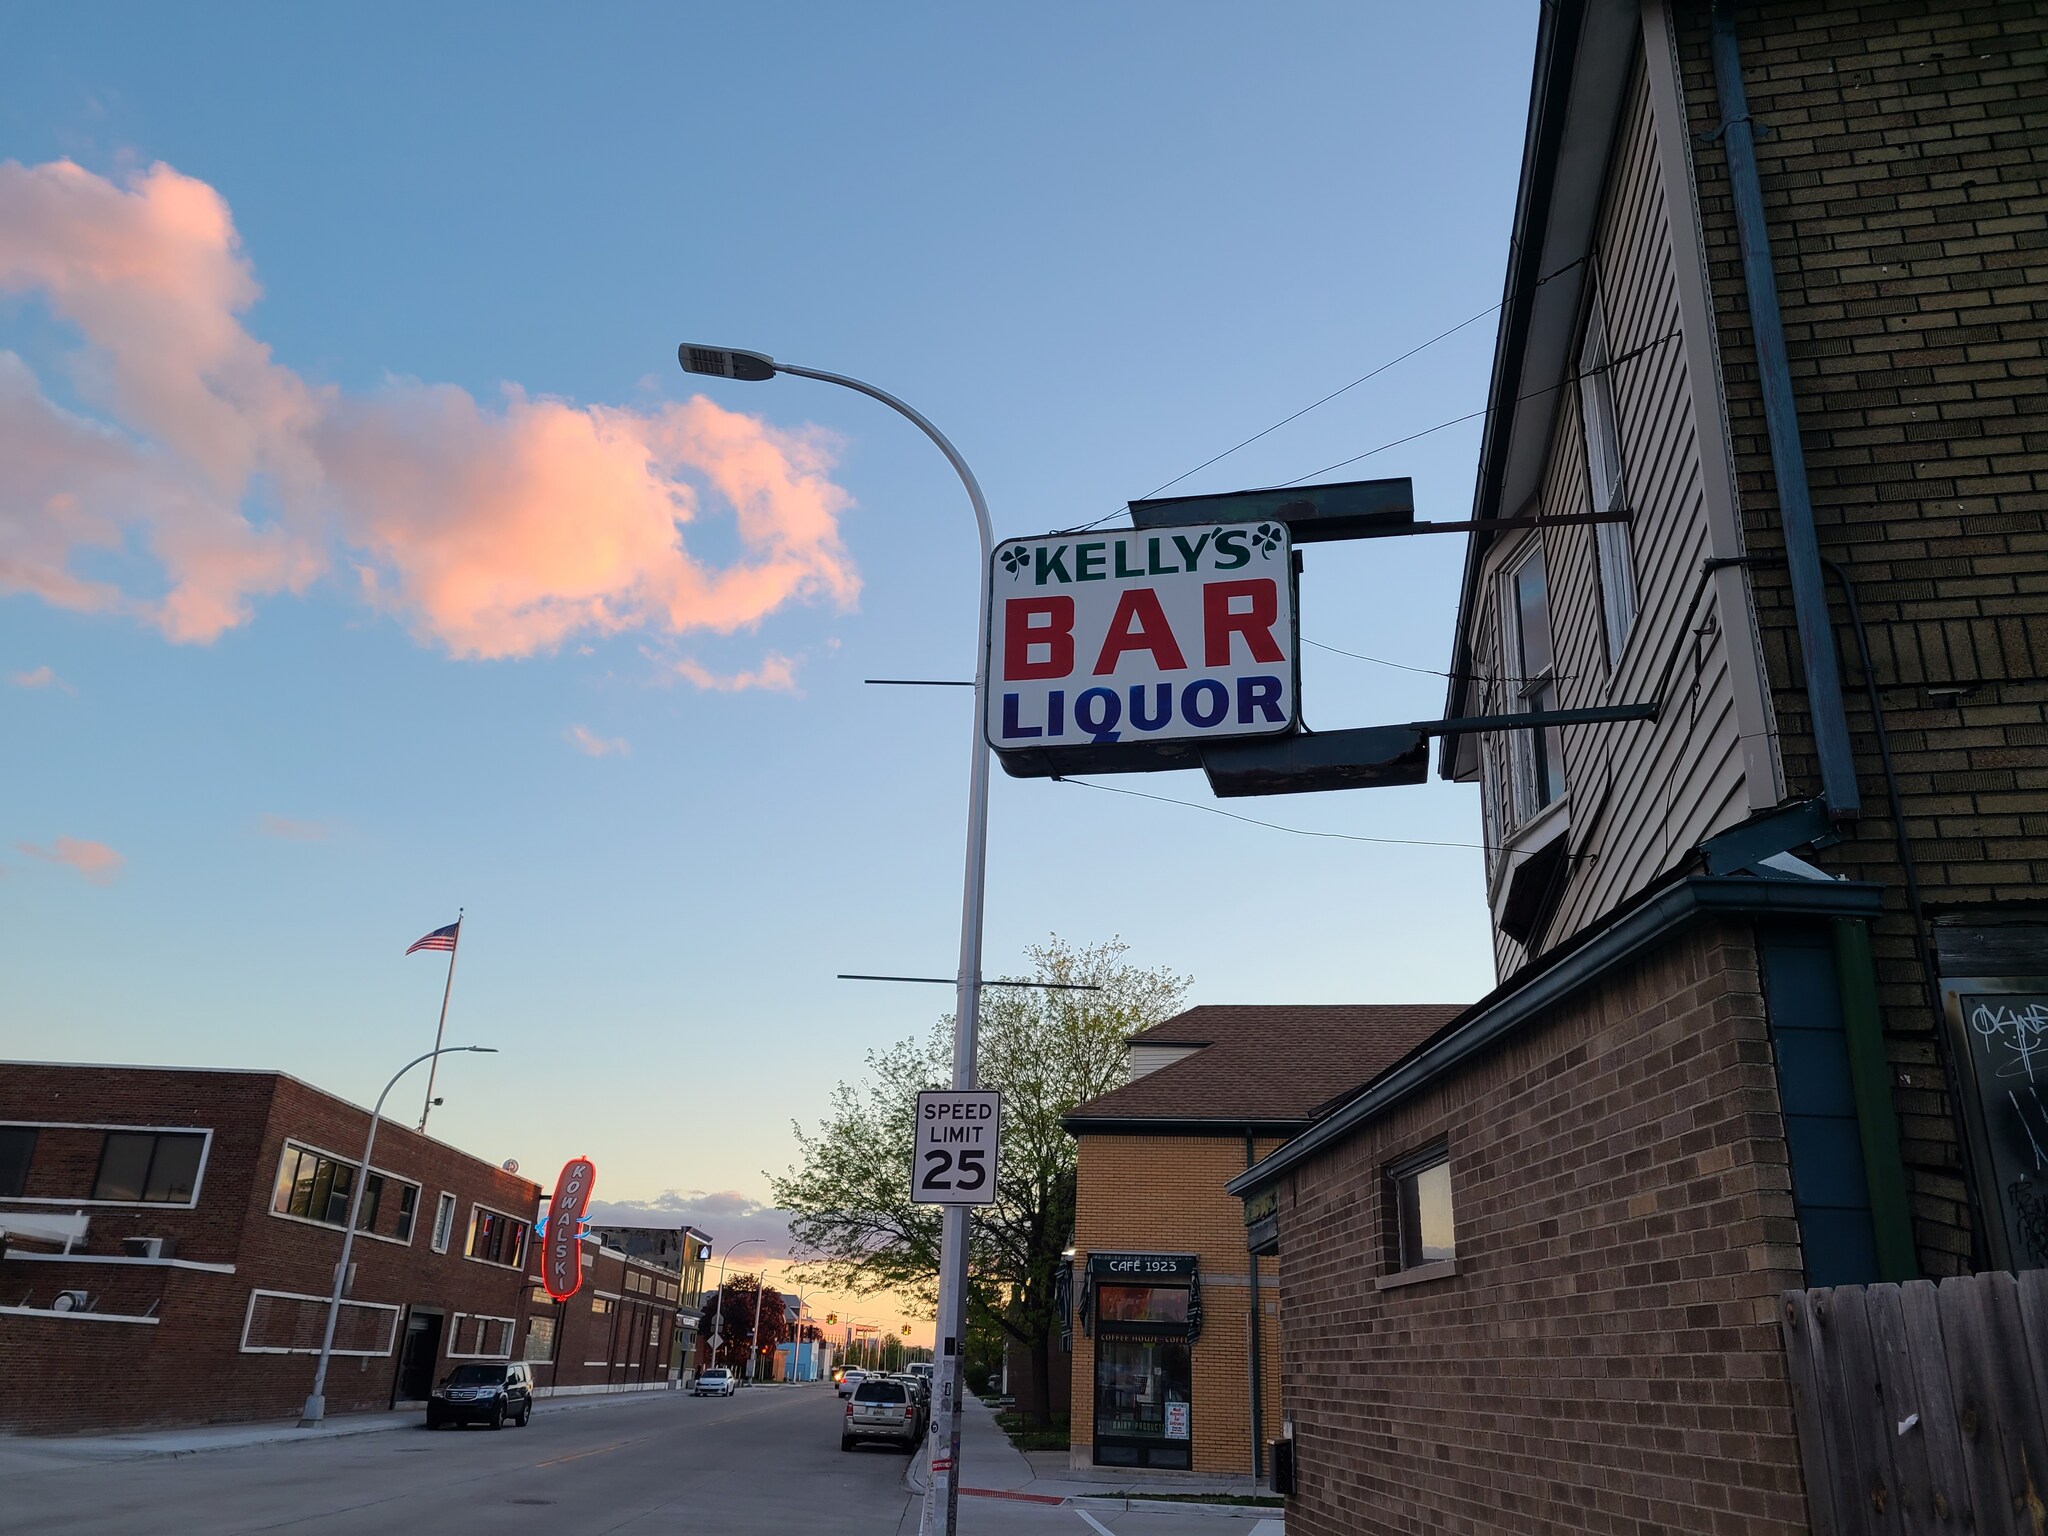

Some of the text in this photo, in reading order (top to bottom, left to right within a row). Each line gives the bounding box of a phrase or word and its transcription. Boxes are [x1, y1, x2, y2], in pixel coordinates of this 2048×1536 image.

[1035, 526, 1251, 585] KELLY'S
[1003, 578, 1286, 681] BAR
[1002, 675, 1287, 744] LIQUOR
[924, 1103, 992, 1120] SPEED
[930, 1126, 984, 1143] LIMIT
[922, 1149, 986, 1191] 25
[554, 1165, 587, 1290] KOWALSKI
[1109, 1259, 1177, 1272] CAFÉ 1923
